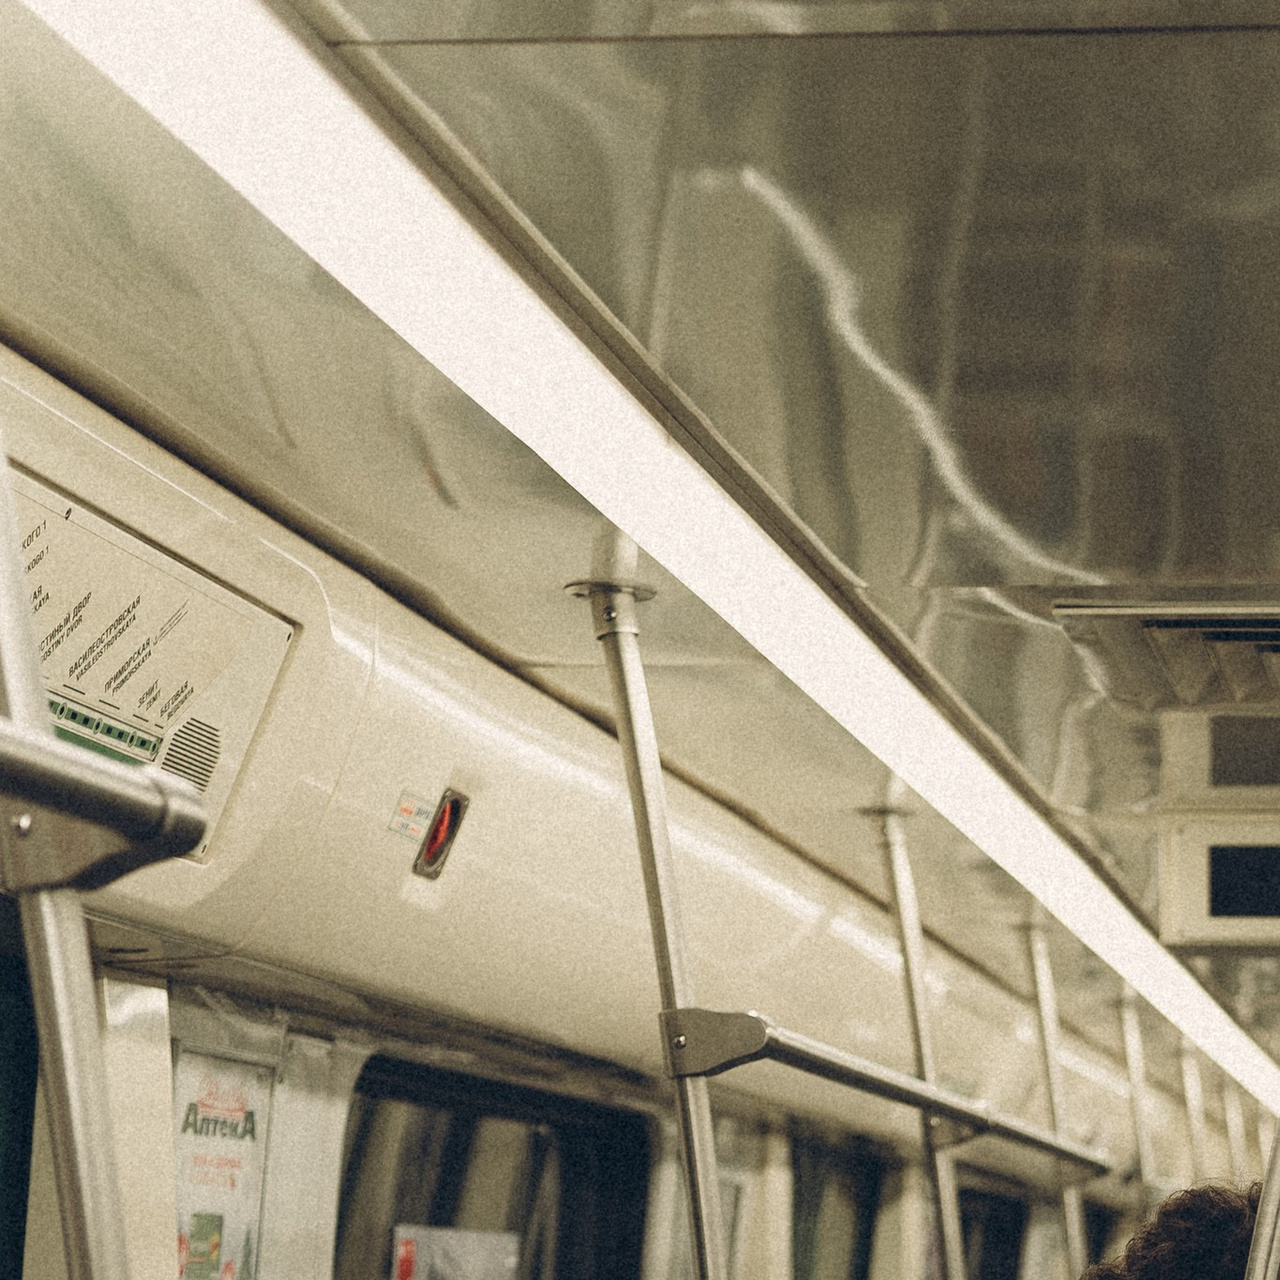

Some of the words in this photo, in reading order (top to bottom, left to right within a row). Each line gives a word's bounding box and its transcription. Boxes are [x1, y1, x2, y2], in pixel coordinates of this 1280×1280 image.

[22, 526, 41, 550] КОГО
[25, 551, 45, 573] KOGO
[39, 613, 70, 651] СТИНЫЙ
[72, 592, 92, 621] ДВОР
[66, 615, 83, 637] DVOR
[69, 595, 141, 677] ВАСИЛЕОСТРОВСКАЯ
[76, 614, 136, 681] VASILEOSTROVSKAYA
[105, 637, 150, 692] ПРИМОРСКАЯ
[112, 650, 151, 696] PRIMORSKAYA
